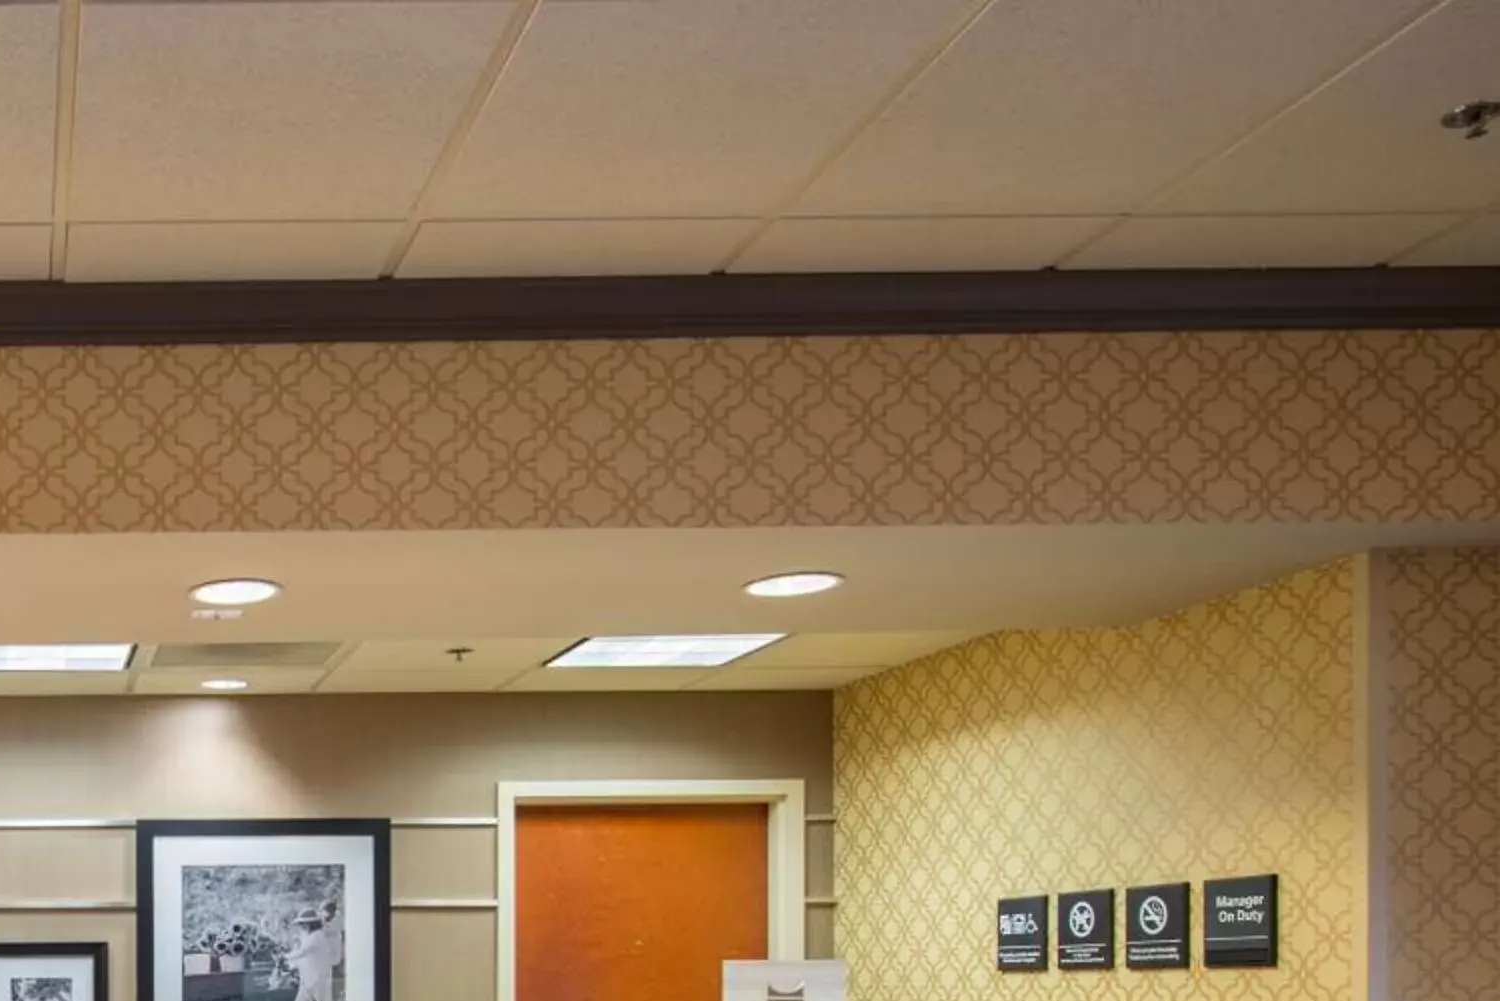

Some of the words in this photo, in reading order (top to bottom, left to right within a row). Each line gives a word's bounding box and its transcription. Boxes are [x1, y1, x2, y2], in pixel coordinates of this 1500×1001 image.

[1215, 895, 1265, 909] Manager
[1218, 910, 1235, 923] On
[1237, 909, 1265, 924] Duty
